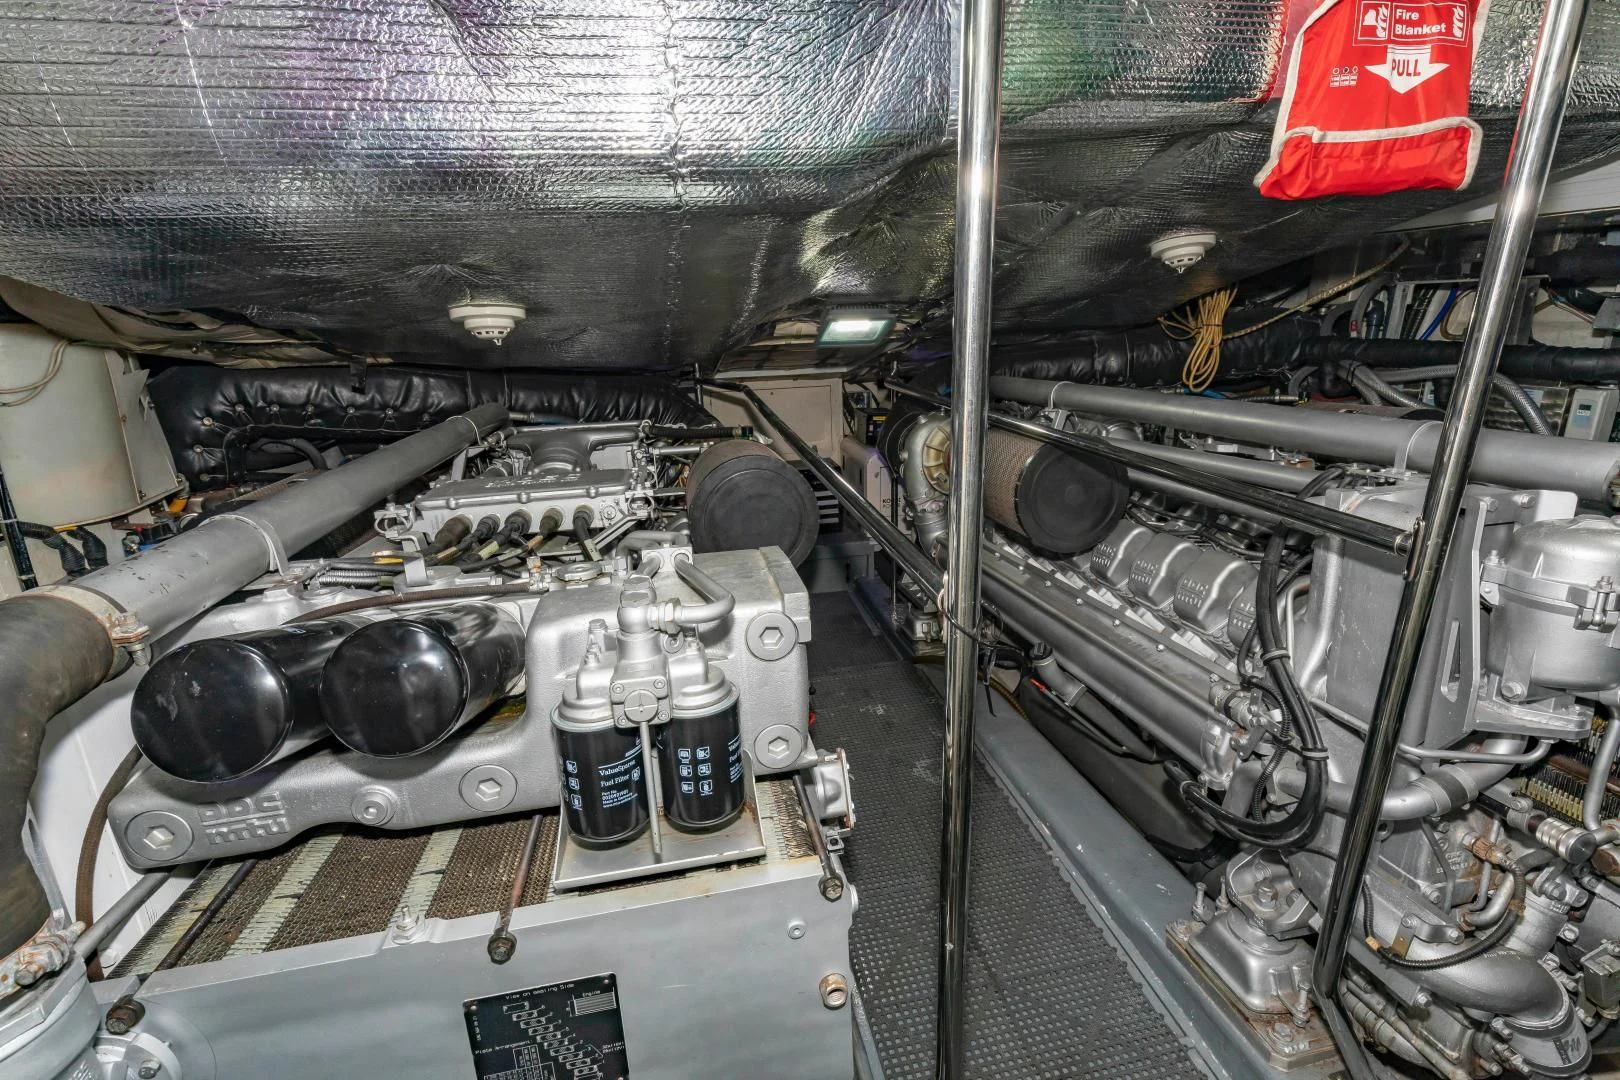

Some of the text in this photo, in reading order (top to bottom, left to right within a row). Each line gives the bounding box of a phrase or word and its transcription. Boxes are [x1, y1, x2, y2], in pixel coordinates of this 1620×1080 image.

[1396, 9, 1419, 20] Fire
[1395, 22, 1446, 36] Blanket
[1391, 58, 1421, 77] PULL
[600, 774, 630, 788] Fuel Filter
